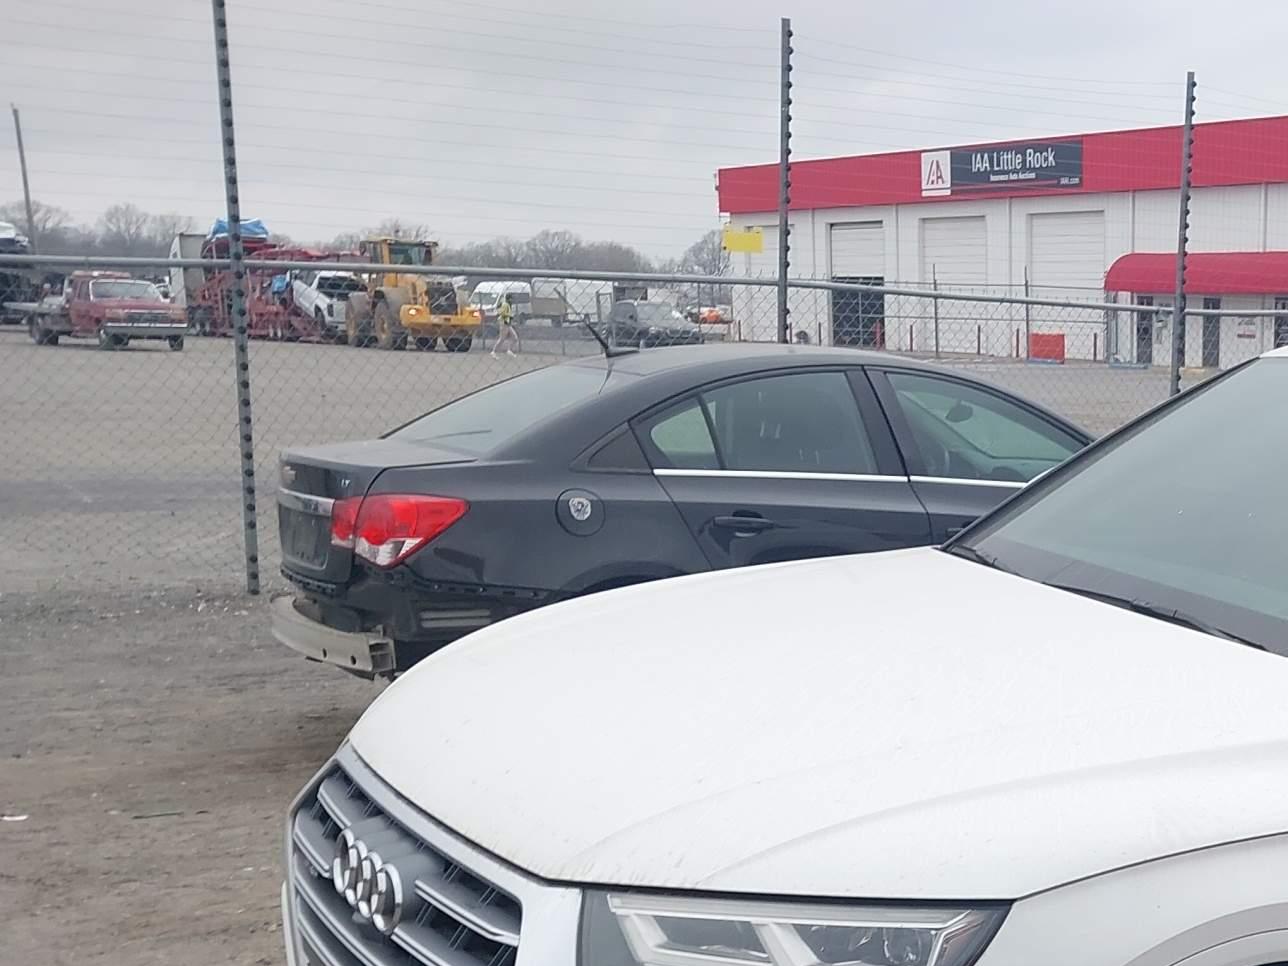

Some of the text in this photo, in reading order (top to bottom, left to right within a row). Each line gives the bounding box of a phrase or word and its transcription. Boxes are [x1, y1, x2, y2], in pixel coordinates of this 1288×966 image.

[971, 148, 1056, 172] IAA Little Rock
